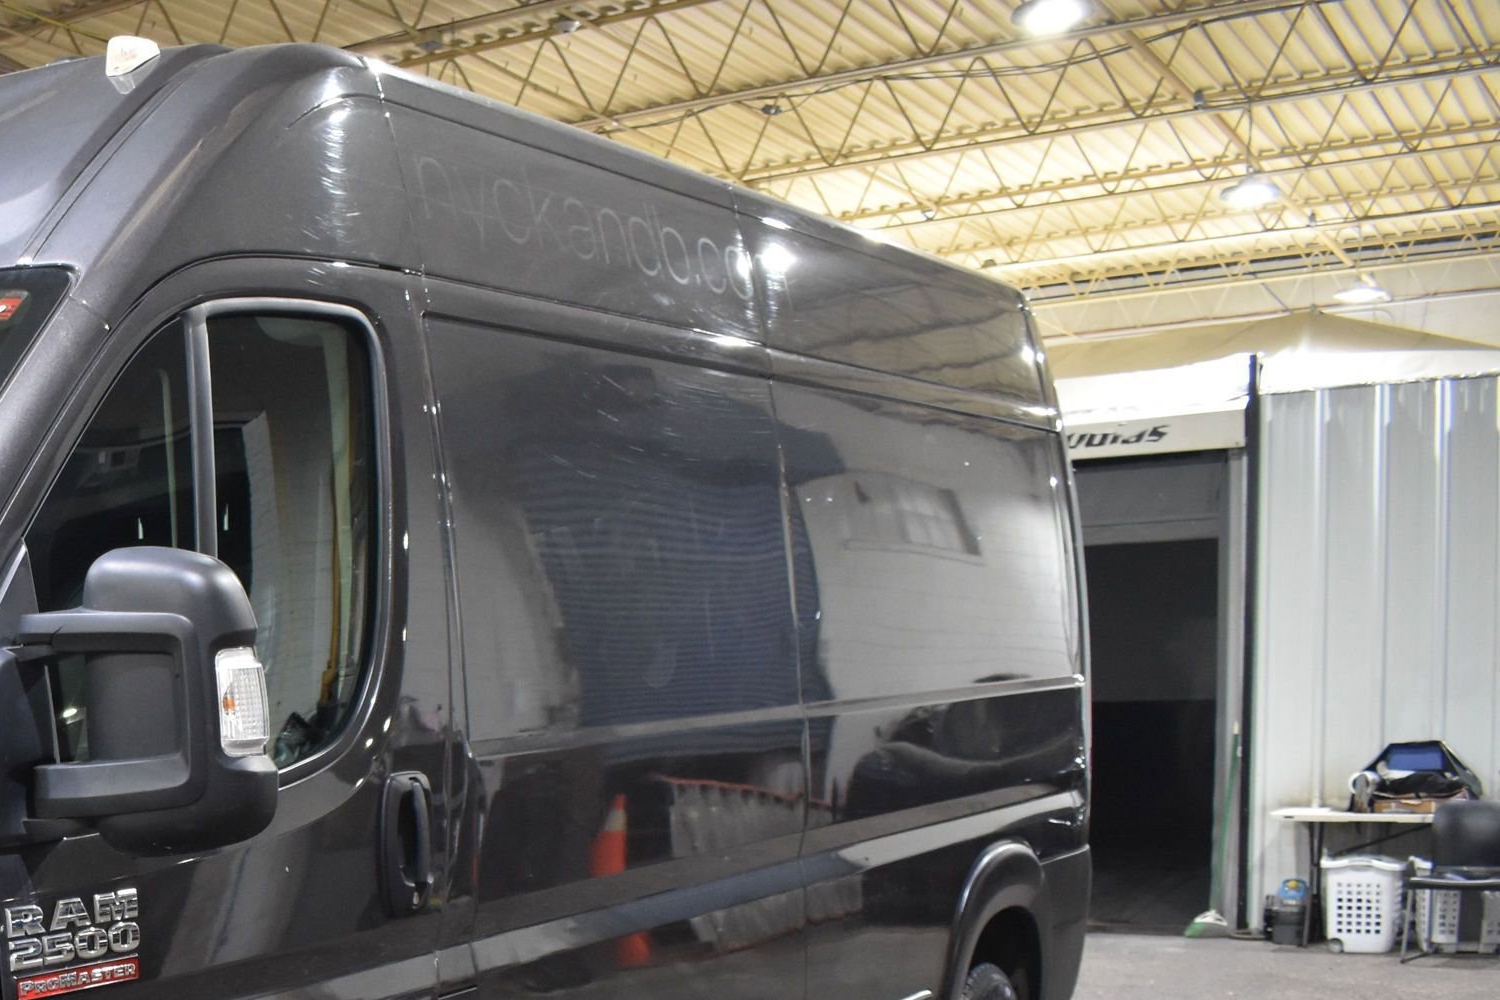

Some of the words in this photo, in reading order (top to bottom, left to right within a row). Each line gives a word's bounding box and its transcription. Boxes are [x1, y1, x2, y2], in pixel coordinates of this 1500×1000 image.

[5, 887, 139, 938] RAM
[8, 921, 140, 972] 2500
[18, 961, 137, 996] PROMASTER
